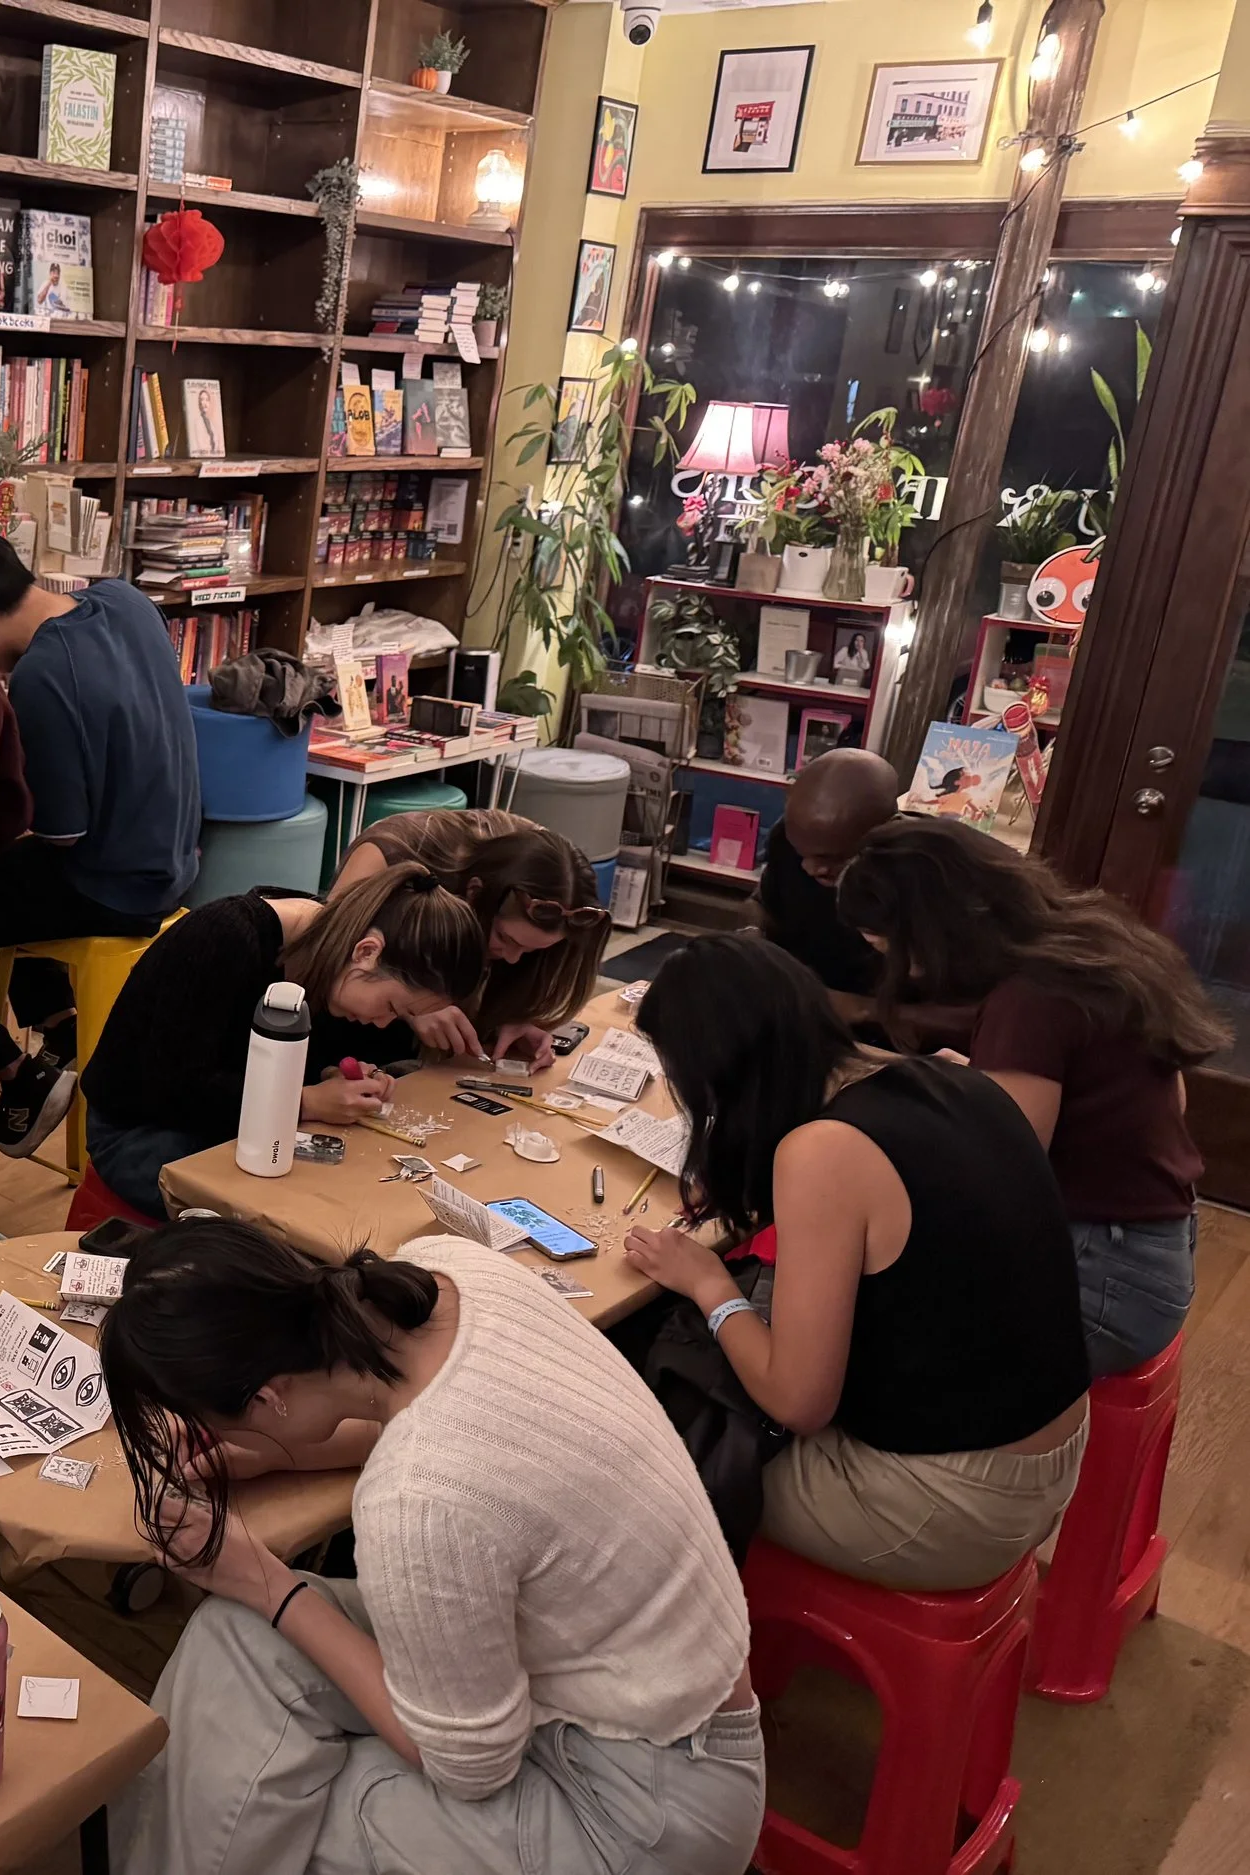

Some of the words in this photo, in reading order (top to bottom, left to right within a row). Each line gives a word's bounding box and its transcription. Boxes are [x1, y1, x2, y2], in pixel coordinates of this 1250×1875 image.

[607, 1064, 627, 1090] PRINT
[620, 1068, 641, 1094] BLOCK
[271, 1140, 280, 1164] owala
